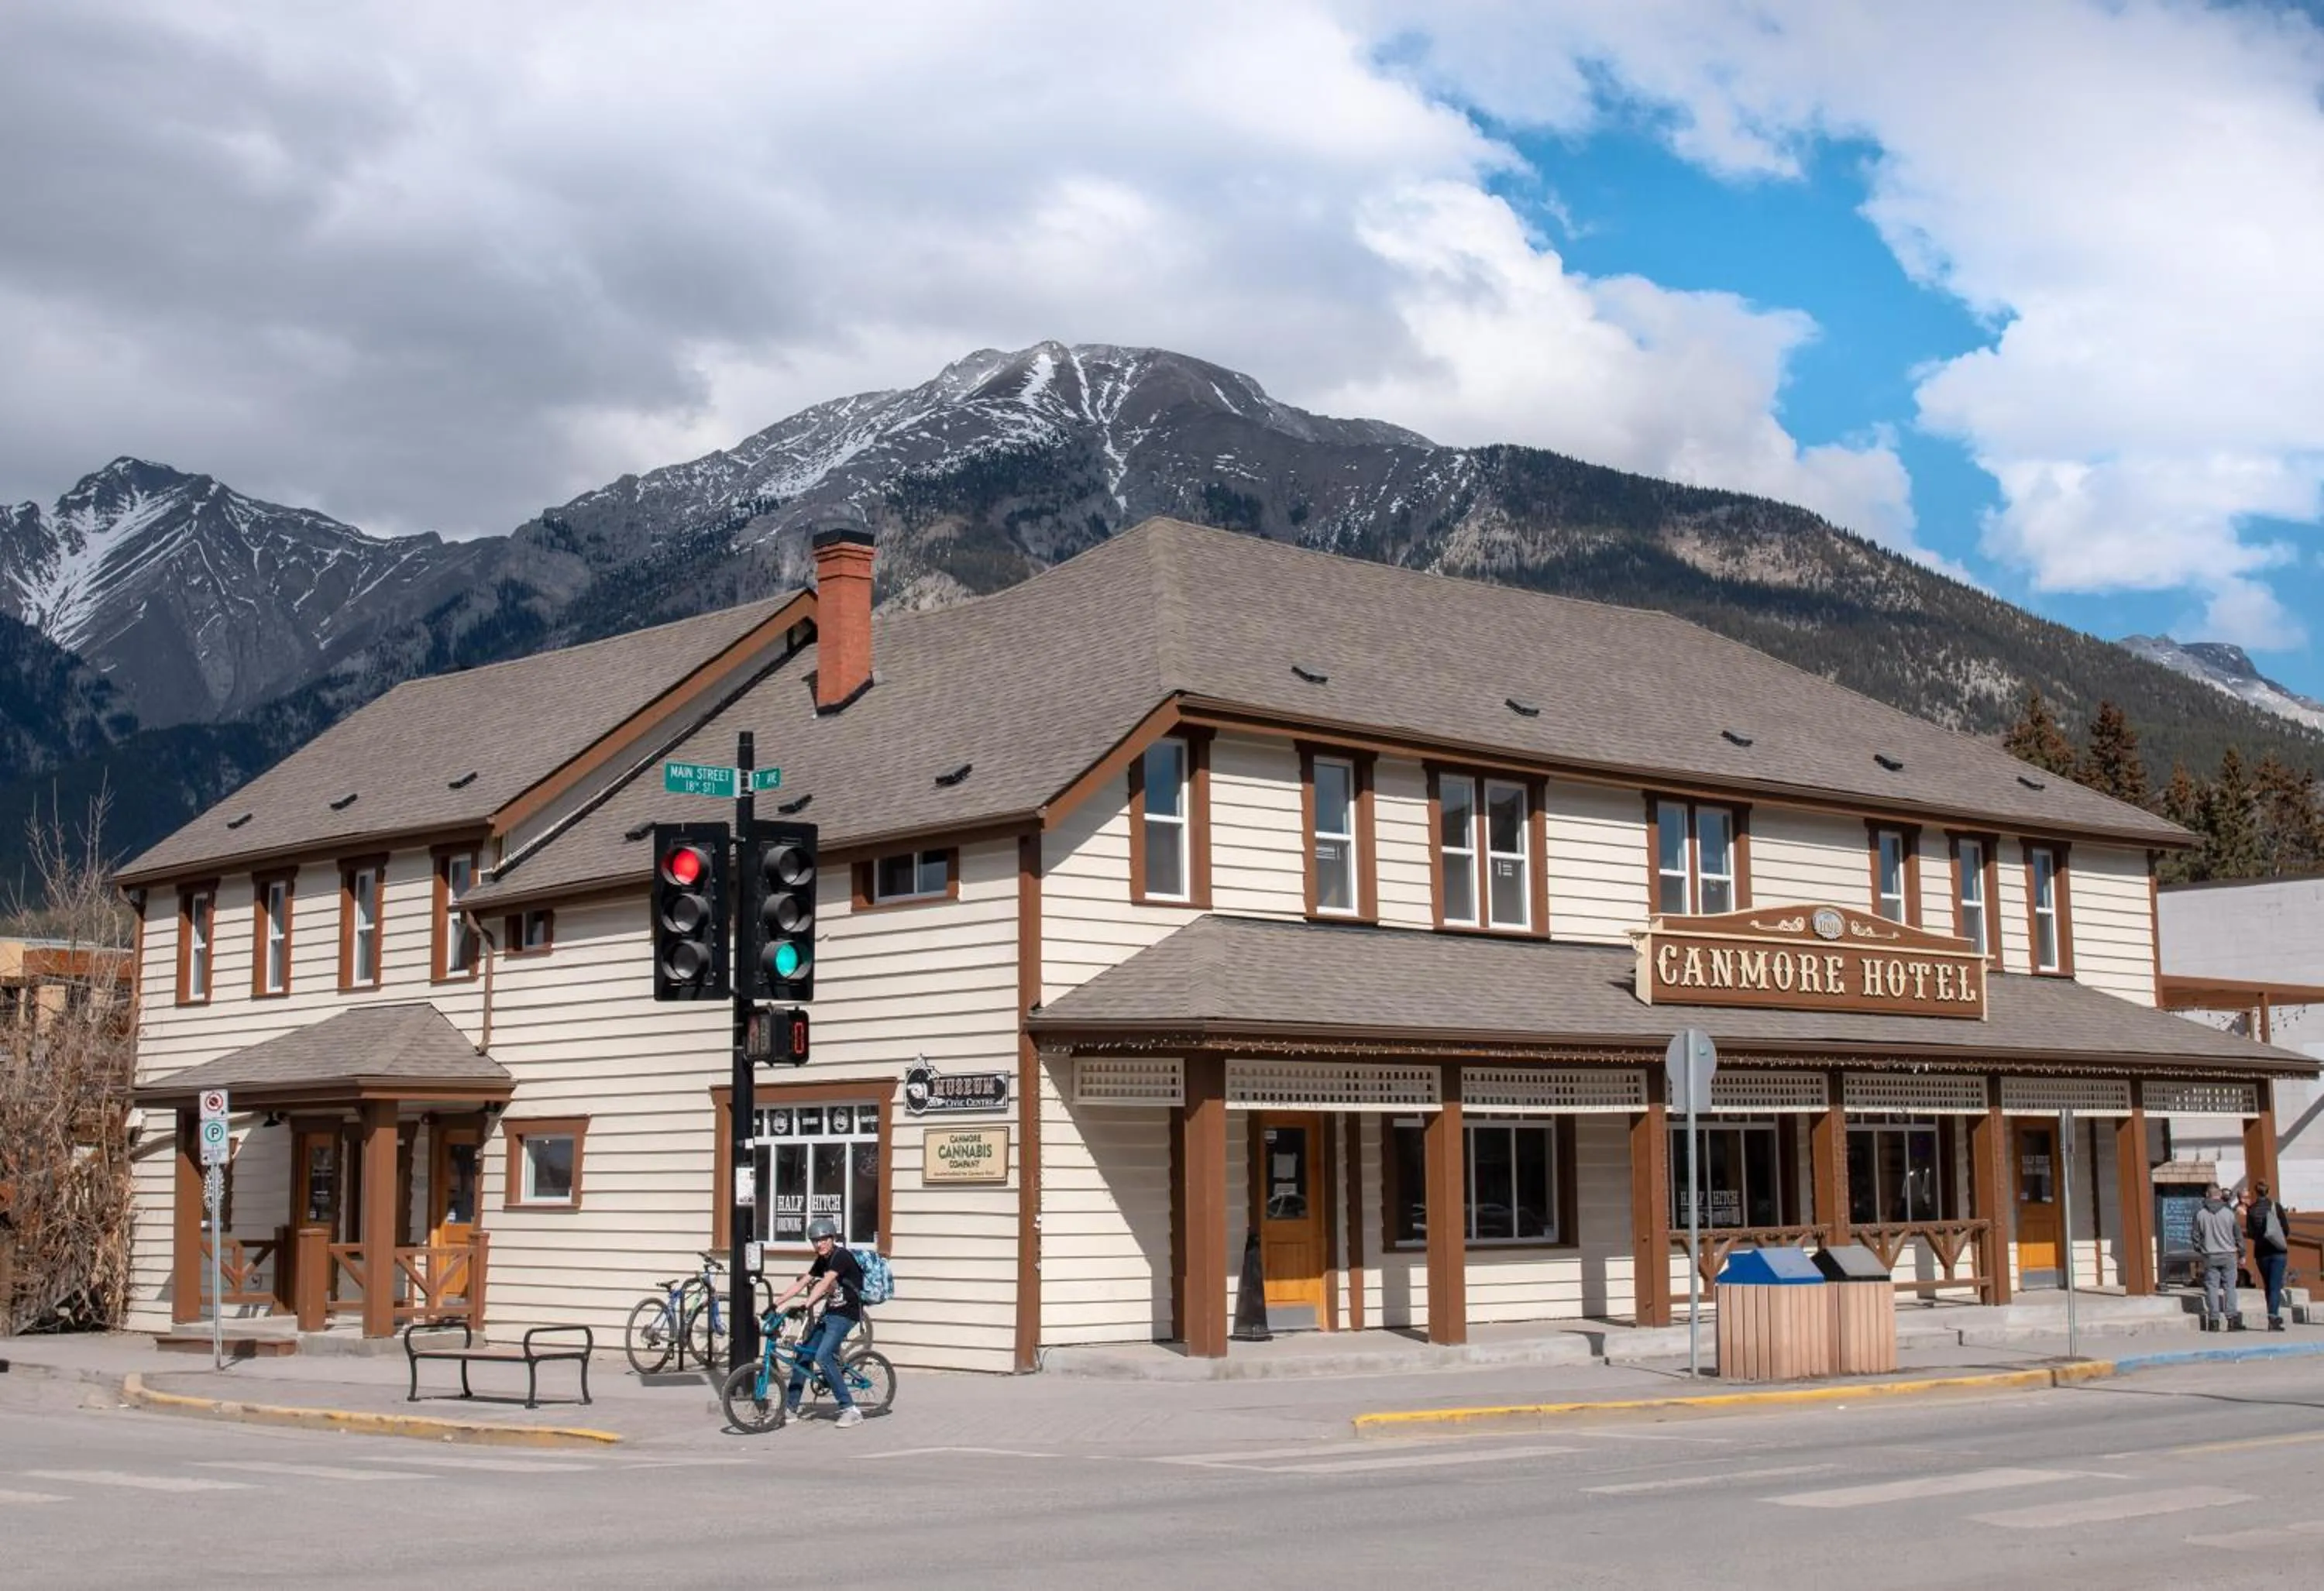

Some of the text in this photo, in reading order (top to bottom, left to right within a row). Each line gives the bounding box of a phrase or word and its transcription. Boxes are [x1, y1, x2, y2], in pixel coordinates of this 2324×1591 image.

[670, 765, 730, 781] MAIN STREET
[766, 771, 777, 785] AVE
[1655, 943, 1978, 1002] CANMORE HOTEL
[932, 1077, 996, 1097] MUSEUM
[949, 1133, 982, 1144] CANMORE
[937, 1143, 992, 1160] CANNABIS
[948, 1159, 980, 1169] COMPANY
[776, 1194, 841, 1211] HALF HITCH
[1679, 1189, 1739, 1207] HF HITCH
